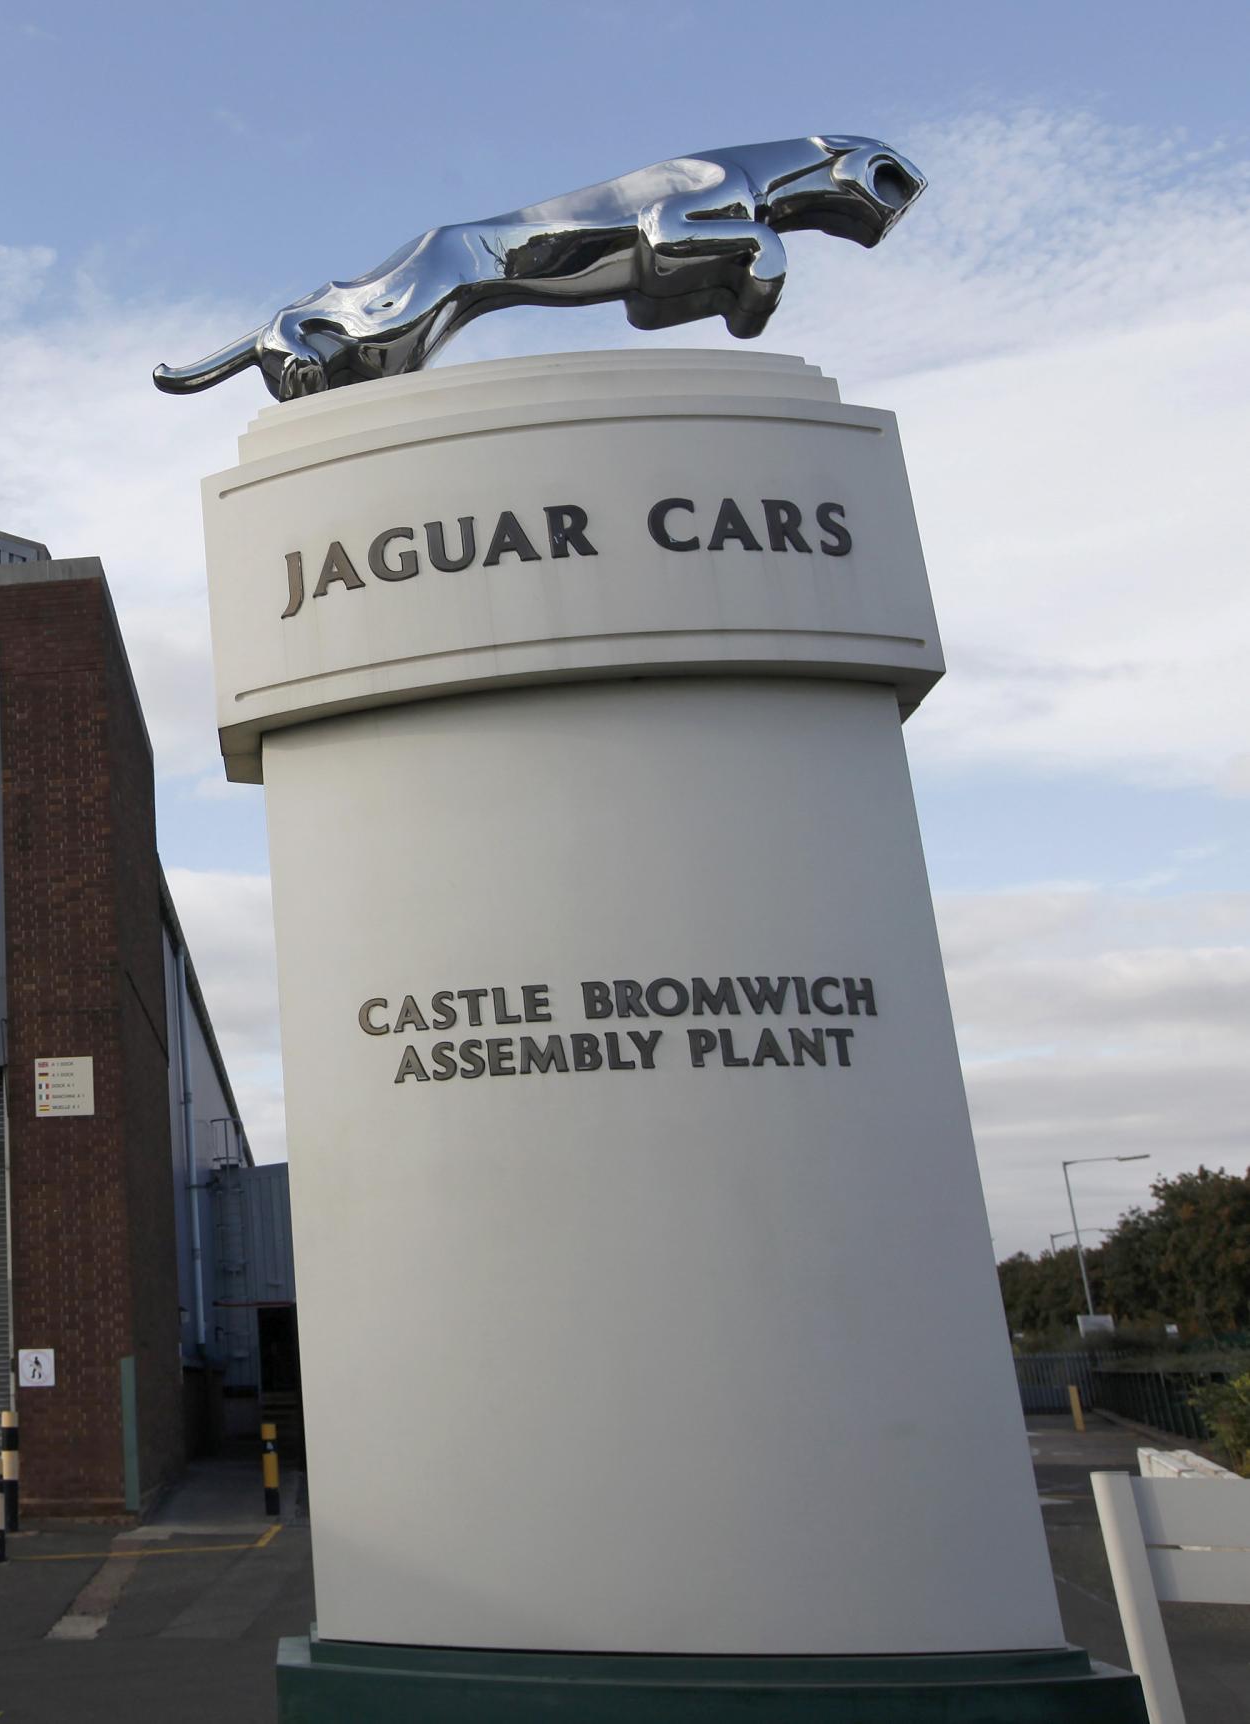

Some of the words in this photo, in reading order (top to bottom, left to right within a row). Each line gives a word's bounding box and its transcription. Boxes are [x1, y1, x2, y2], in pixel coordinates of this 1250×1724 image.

[280, 503, 598, 619] JAGUAR
[646, 496, 853, 557] CARS
[358, 985, 552, 1035] CASTLE
[581, 976, 878, 1018] BROMWICH
[394, 1030, 662, 1083] ASSEMBLY
[687, 1028, 855, 1067] PLANT
